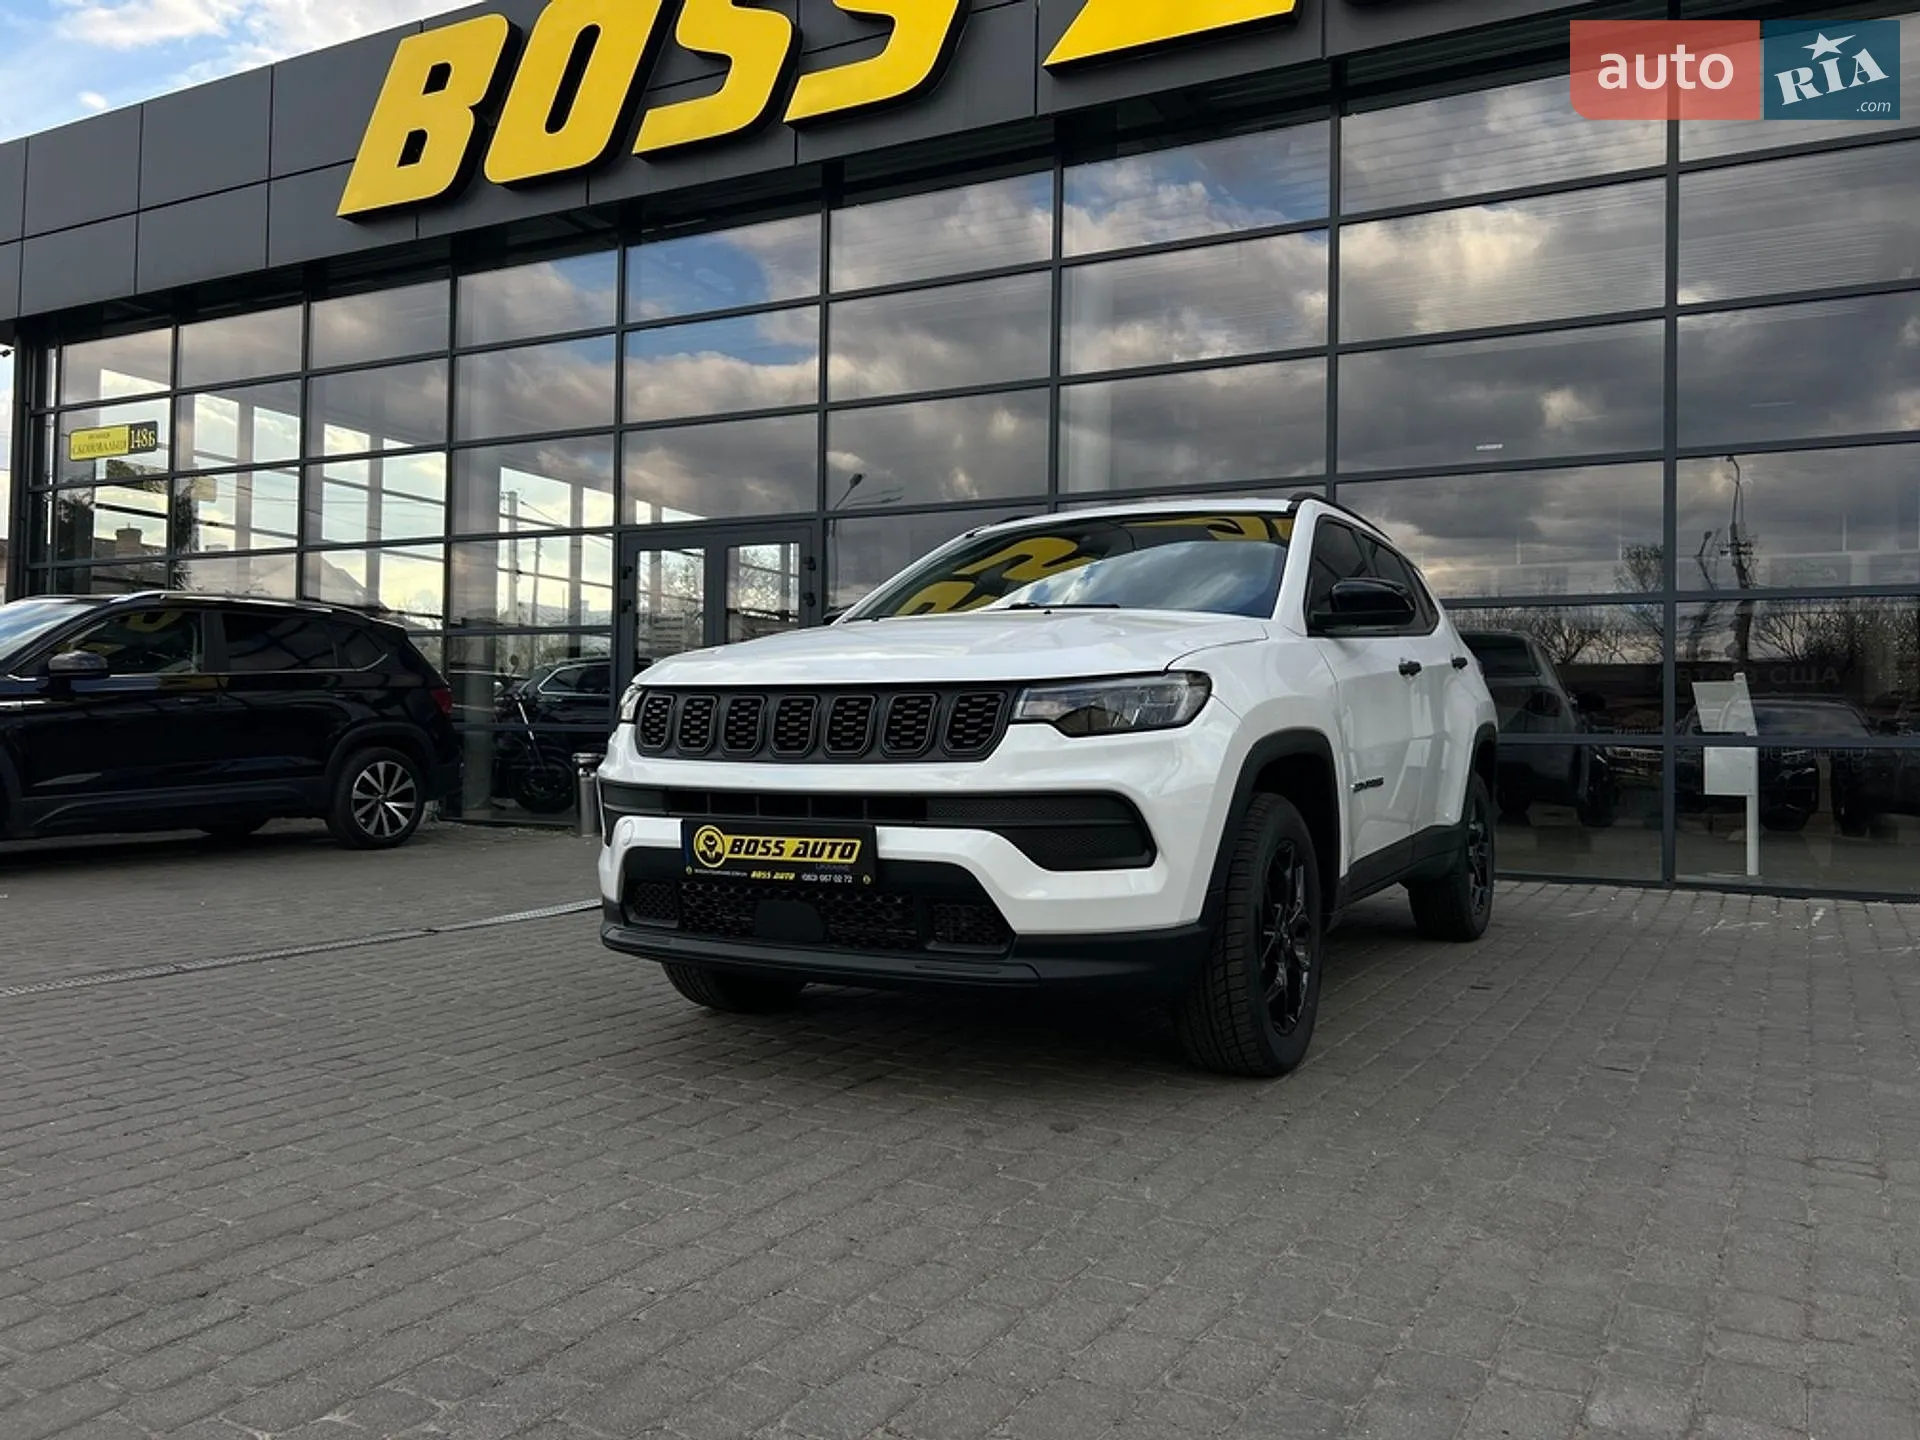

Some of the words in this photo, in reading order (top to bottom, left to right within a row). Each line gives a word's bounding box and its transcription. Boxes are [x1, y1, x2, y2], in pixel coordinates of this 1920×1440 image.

[337, 0, 962, 216] BOSS
[1769, 666, 1840, 685] США
[729, 839, 785, 856] BOSS
[792, 840, 858, 858] AUTO
